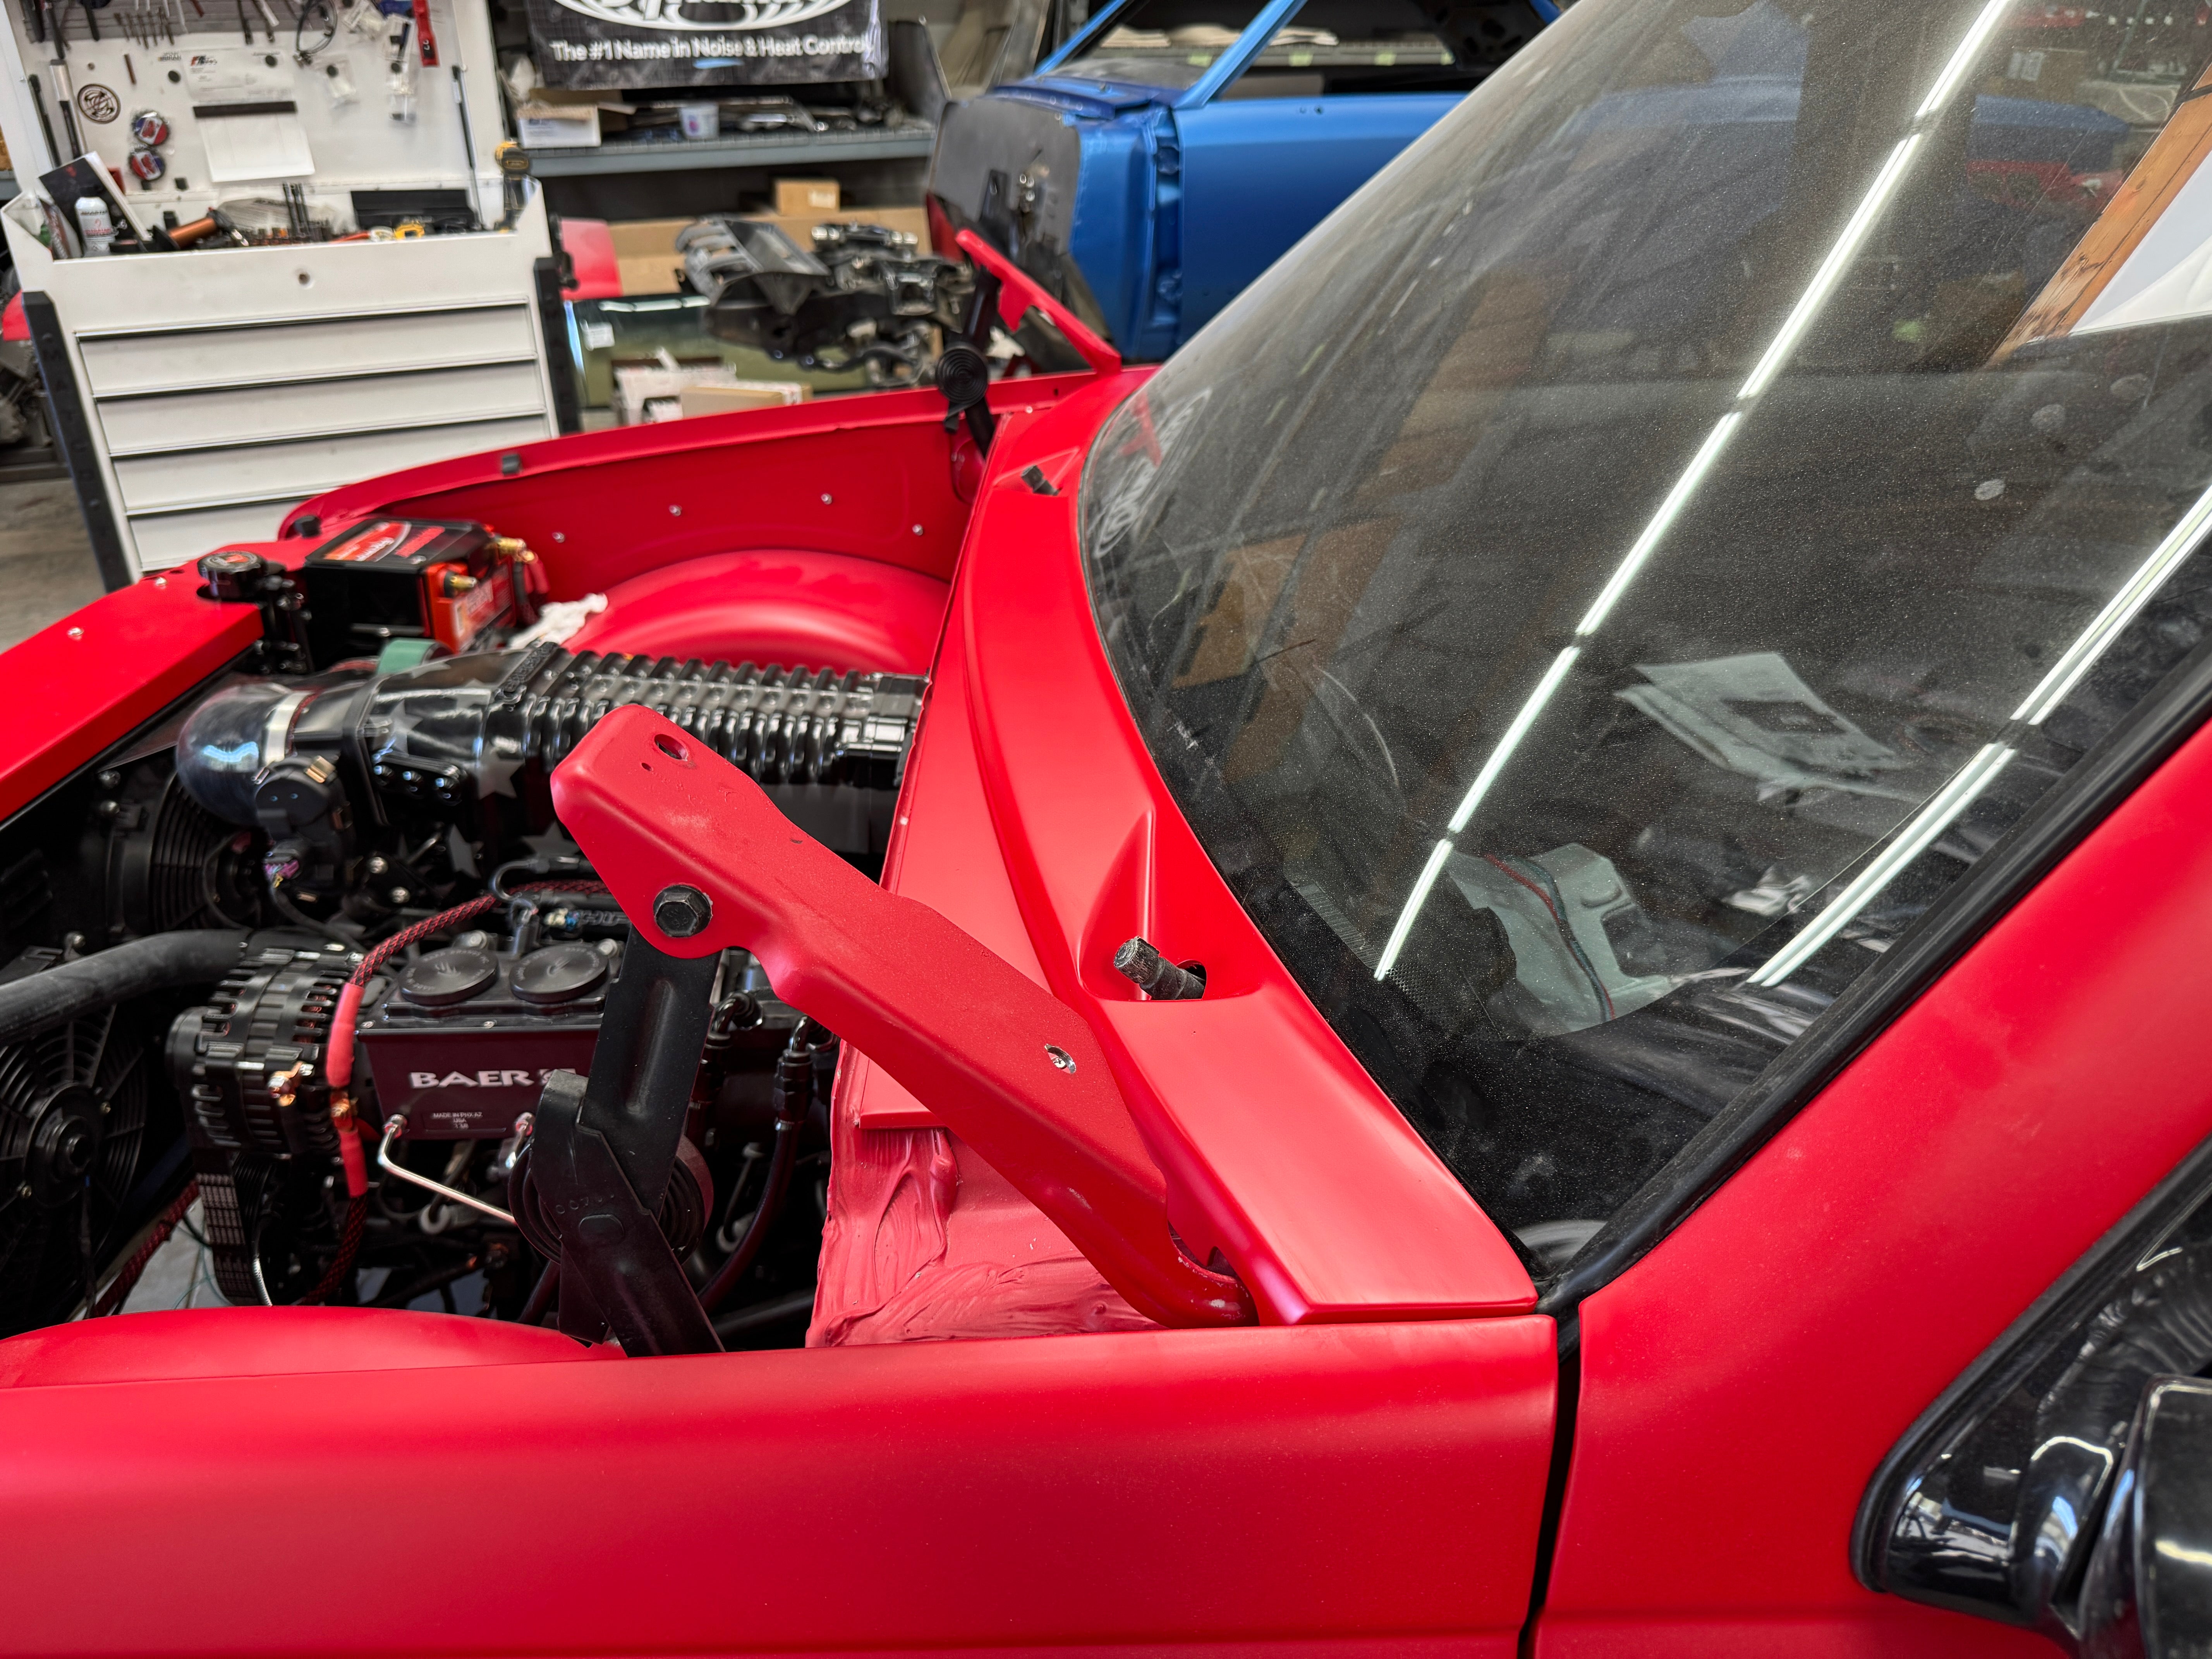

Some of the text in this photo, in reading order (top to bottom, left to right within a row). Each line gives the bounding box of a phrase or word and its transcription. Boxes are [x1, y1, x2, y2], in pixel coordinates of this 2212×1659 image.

[549, 39, 588, 62] The
[588, 39, 613, 61] #1
[612, 38, 672, 60] Name
[671, 36, 692, 58] in
[690, 35, 744, 58] Noise
[743, 36, 759, 57] &
[757, 35, 804, 57] Heat
[409, 1070, 535, 1089] BAER
